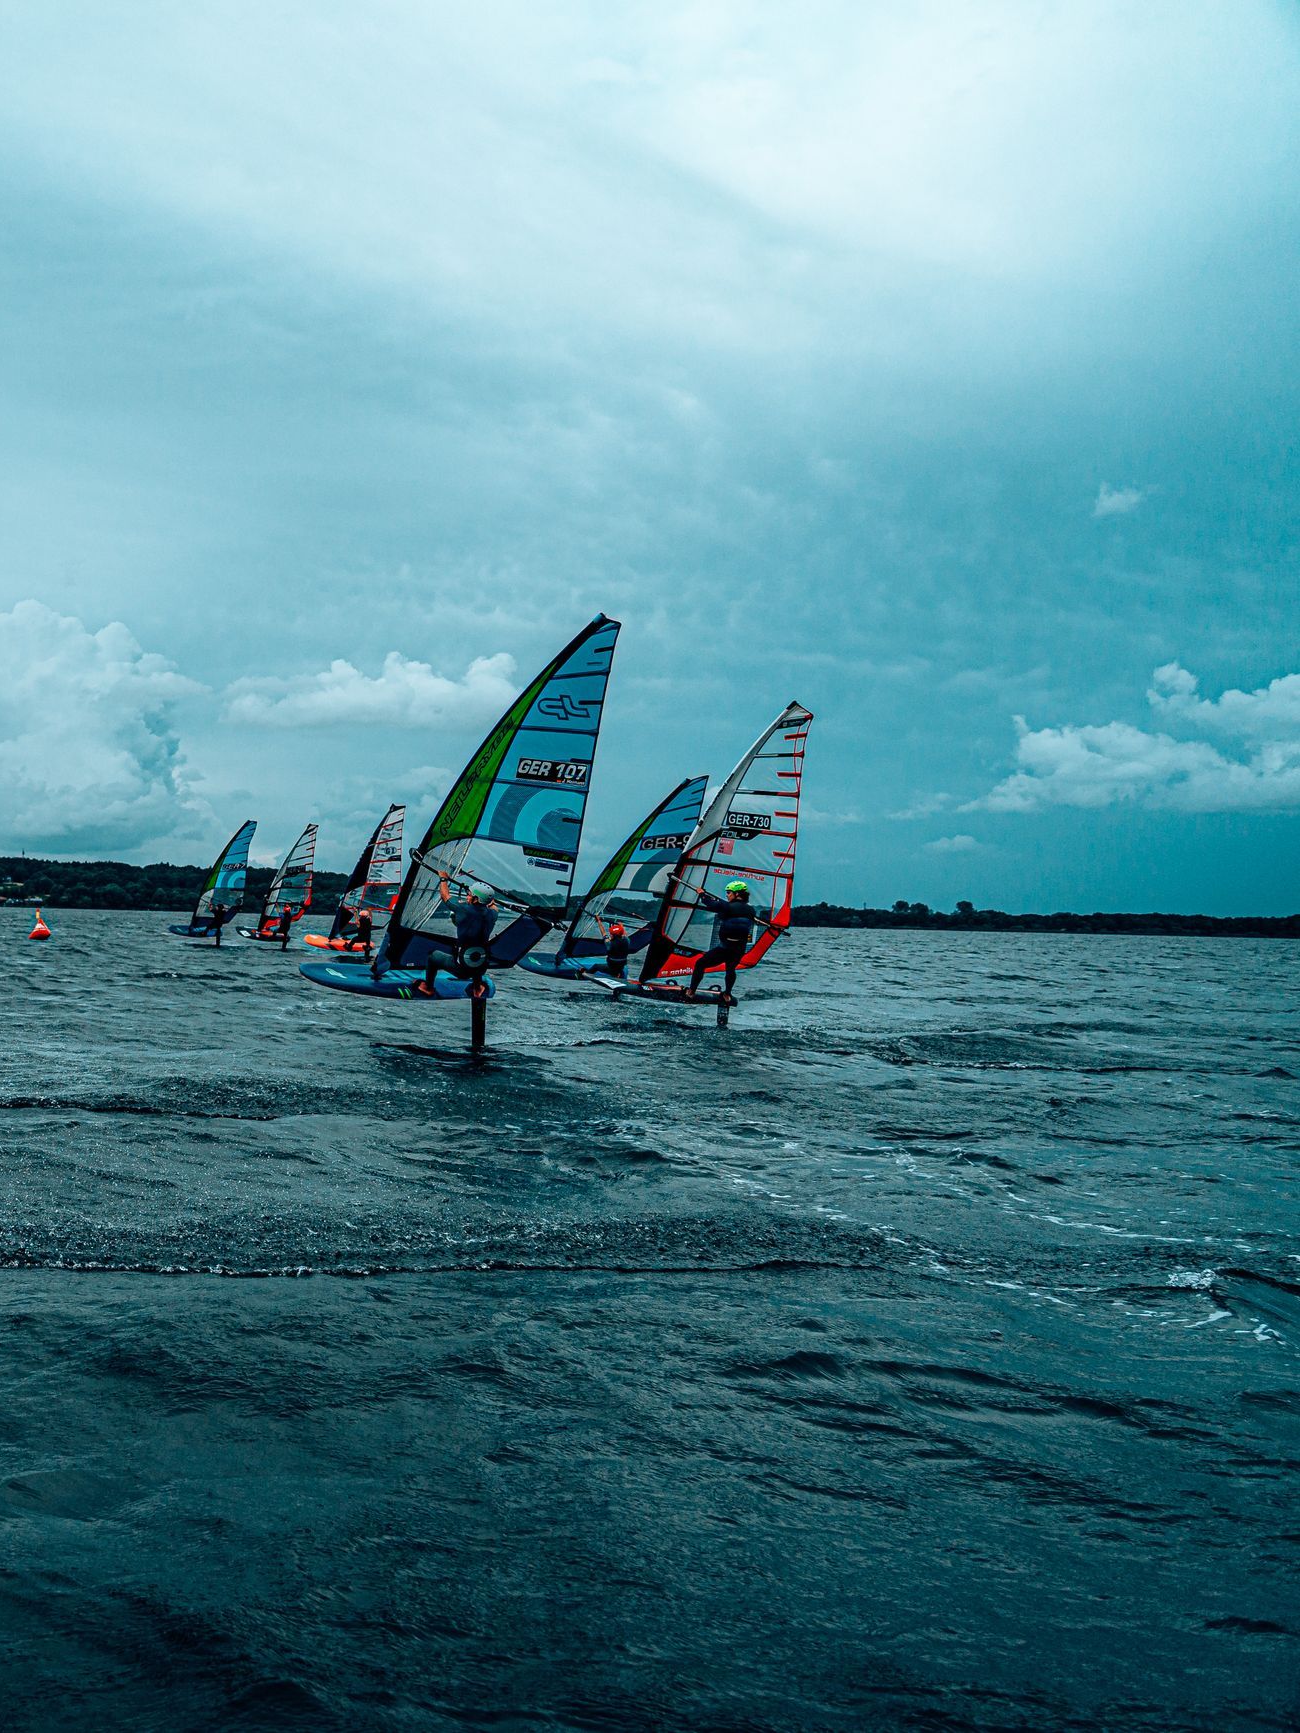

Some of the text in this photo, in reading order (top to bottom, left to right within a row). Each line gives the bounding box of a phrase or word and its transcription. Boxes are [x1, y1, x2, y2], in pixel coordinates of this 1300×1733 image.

[518, 759, 586, 780] GER 107
[728, 812, 770, 828] GER-730
